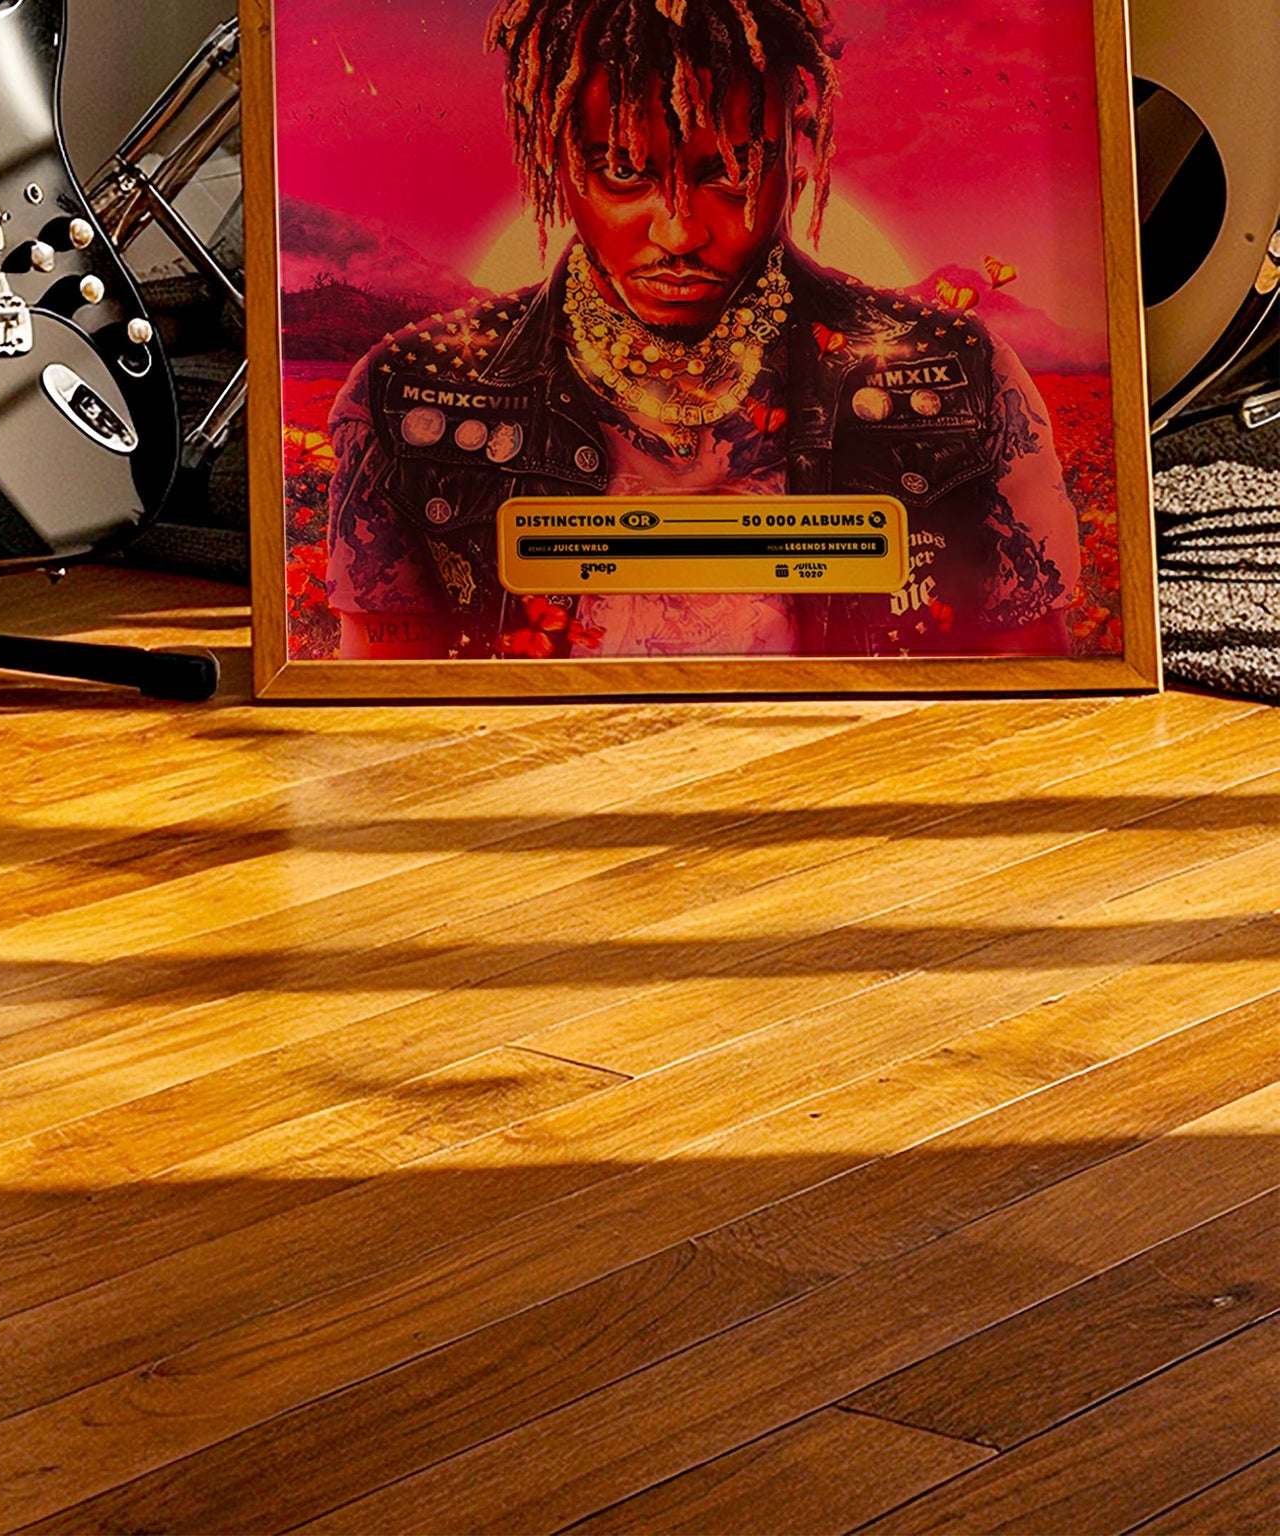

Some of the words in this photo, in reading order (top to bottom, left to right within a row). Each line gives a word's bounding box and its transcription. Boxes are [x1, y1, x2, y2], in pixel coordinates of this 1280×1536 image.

[865, 366, 951, 387] MMXIX
[402, 385, 529, 410] MCMXCVIII
[516, 515, 615, 527] DISTINCTION
[628, 515, 650, 526] OR
[742, 515, 761, 526] 50
[766, 515, 796, 526] 000
[801, 515, 864, 526] ALBUMS
[553, 544, 579, 552] JUICE
[581, 544, 609, 552] WRLD
[785, 542, 826, 551] LEGENDS
[828, 542, 858, 551] NEVER
[861, 542, 876, 551] DIE
[580, 562, 617, 580] snep
[365, 622, 435, 643] WRLD
